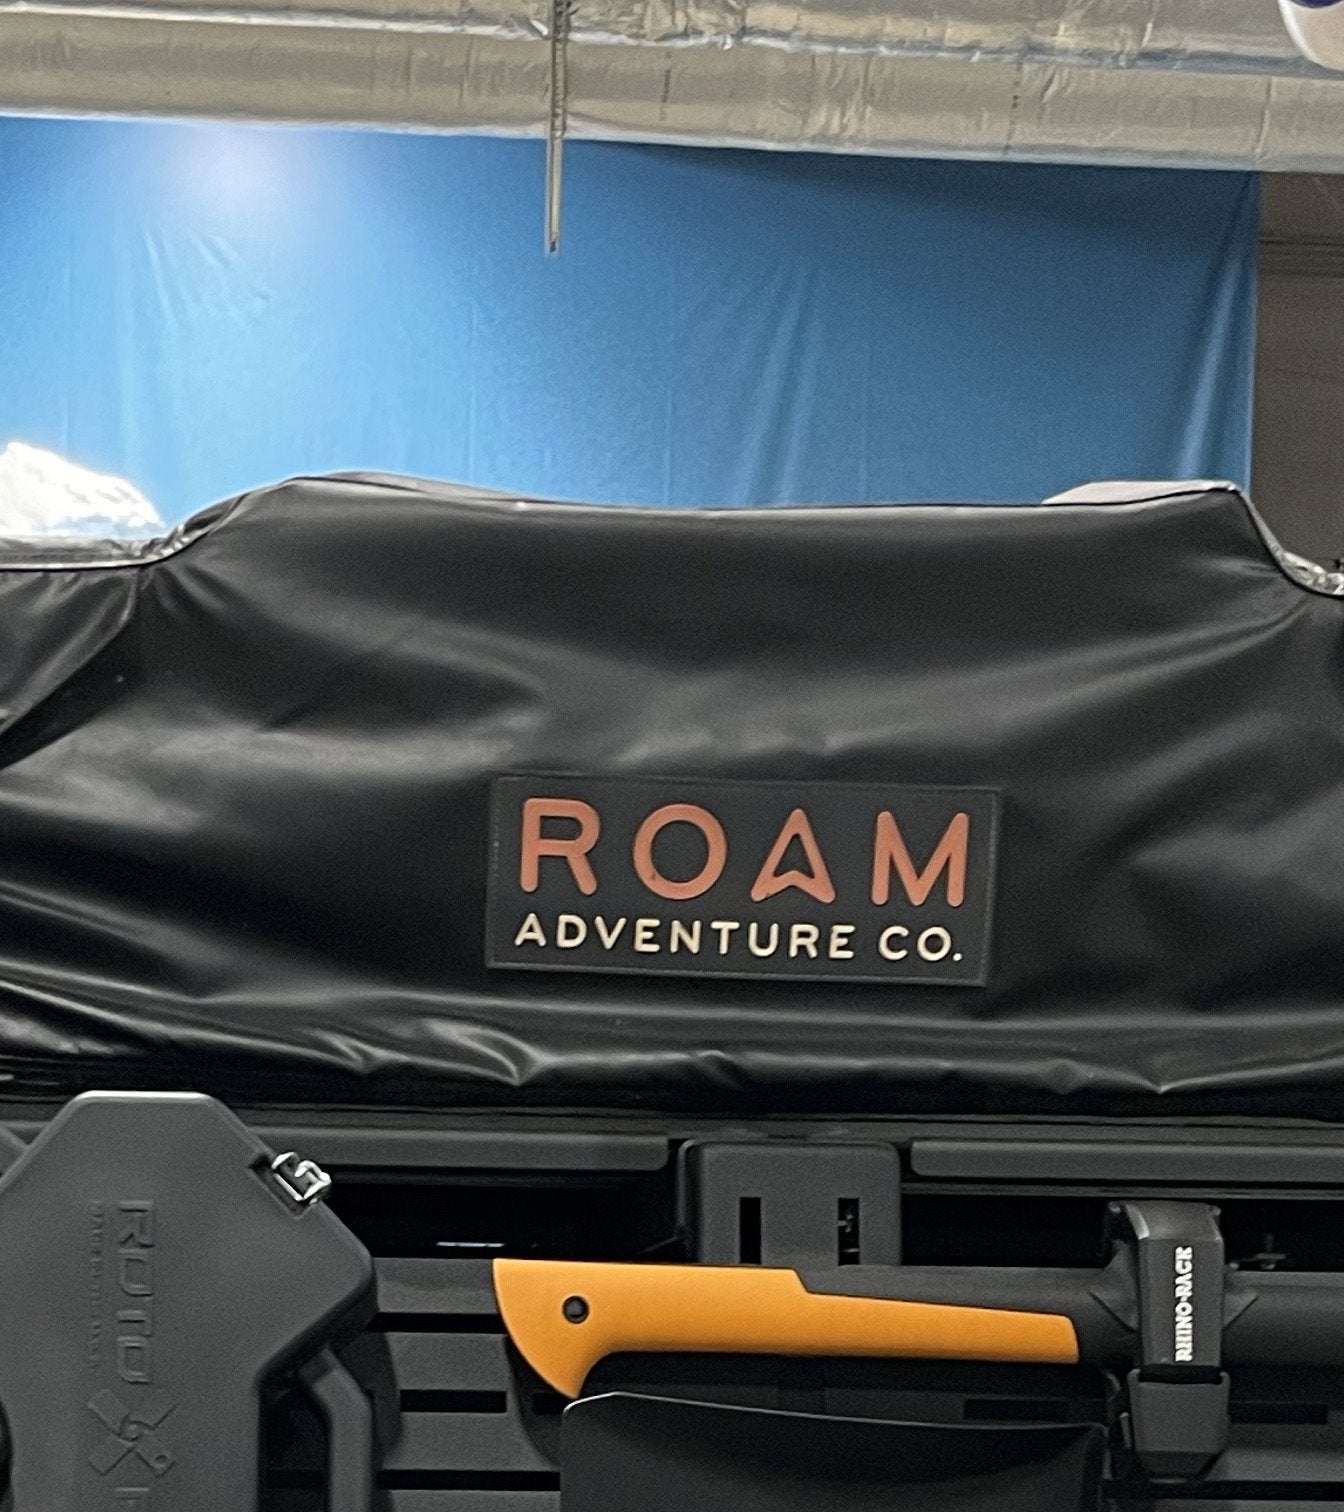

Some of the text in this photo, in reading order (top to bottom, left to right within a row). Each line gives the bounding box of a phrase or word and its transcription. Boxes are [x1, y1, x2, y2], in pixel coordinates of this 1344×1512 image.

[519, 797, 970, 906] ROAM
[514, 912, 963, 962] ADVENTURE CO.
[1175, 1246, 1193, 1362] RHINO-RACK
